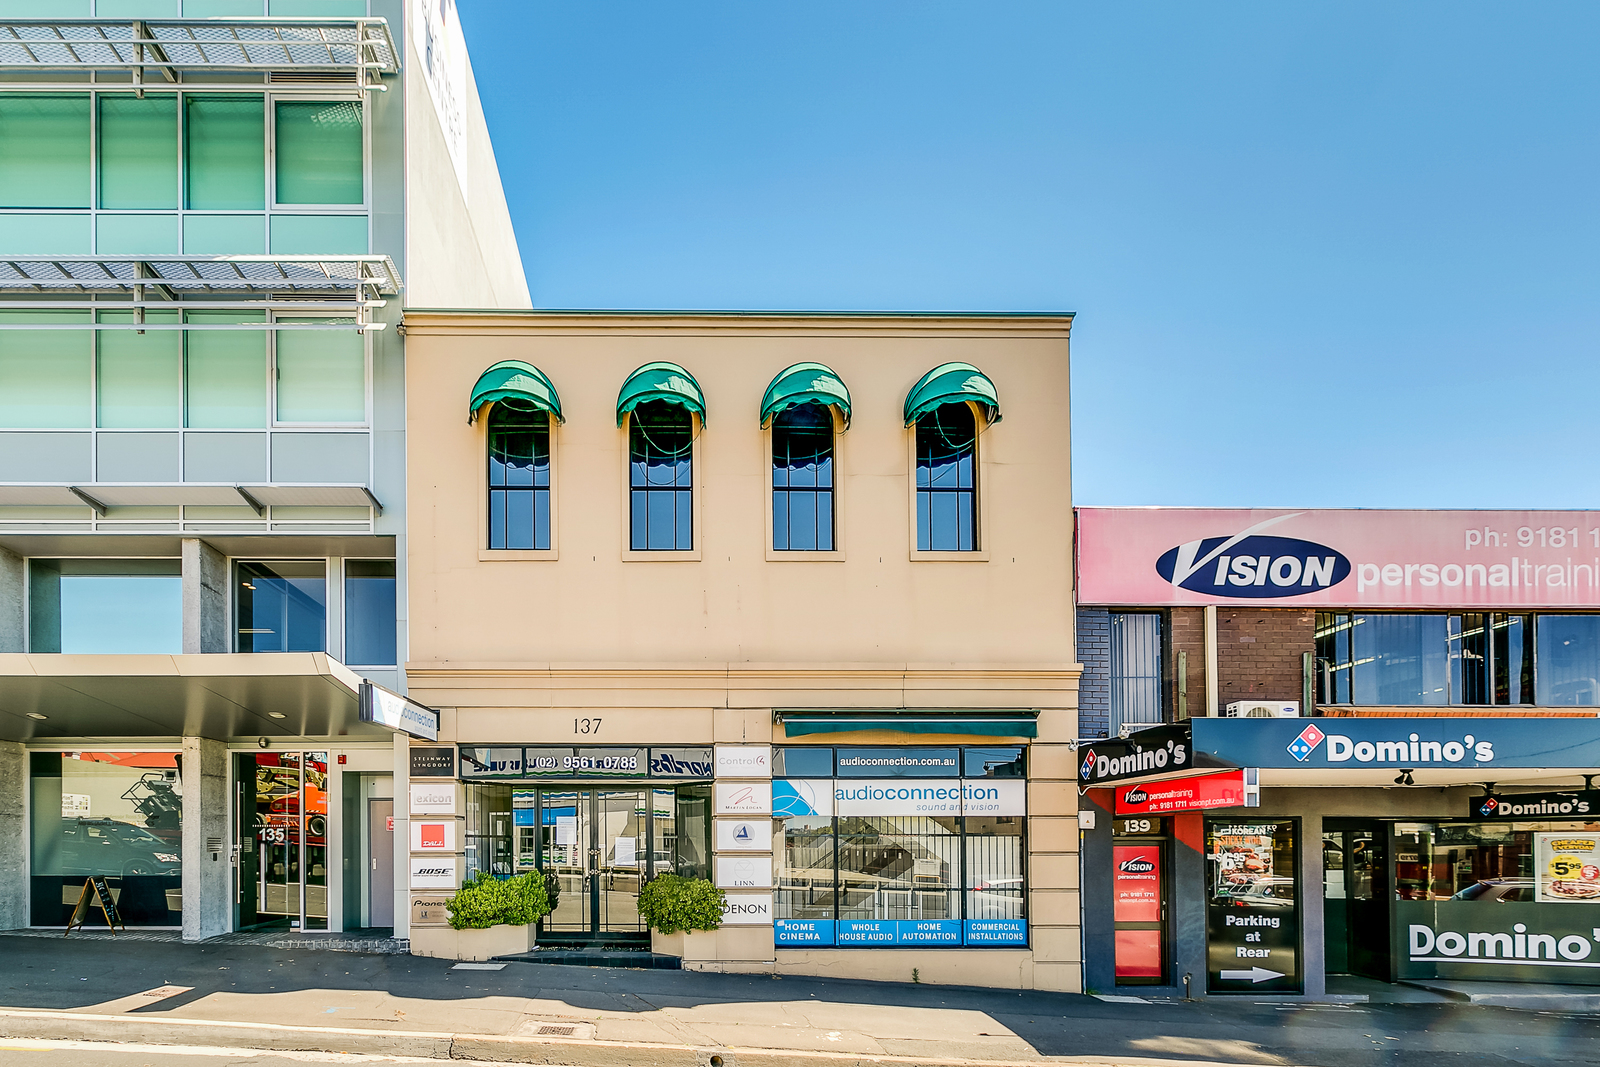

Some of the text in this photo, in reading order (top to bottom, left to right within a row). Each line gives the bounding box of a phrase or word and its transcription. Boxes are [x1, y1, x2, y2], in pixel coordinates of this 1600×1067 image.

[1465, 526, 1508, 550] ph:
[1516, 526, 1578, 548] 9181
[1171, 511, 1336, 587] VISION
[574, 718, 602, 734] 137
[1326, 733, 1494, 762] Domino's
[535, 756, 557, 769] (02)
[563, 756, 595, 769] 9561
[603, 756, 637, 769] 0788
[840, 757, 955, 766] audioconnection.com.au
[1097, 740, 1186, 778] Domino's
[835, 785, 999, 801] audioconnection
[916, 803, 1000, 811] sound and vision
[1498, 799, 1590, 816] Domino's
[1124, 819, 1151, 832] 139
[259, 828, 284, 841] 135
[1121, 855, 1152, 871] VISION
[723, 904, 767, 914] DENON
[784, 923, 815, 931] HOME
[851, 923, 880, 931] WHOLE
[917, 923, 942, 931] HOME
[971, 923, 1020, 931] COMMERCIAL
[1226, 915, 1280, 928] Parking
[1245, 931, 1261, 942] at
[1236, 946, 1271, 958] Rear
